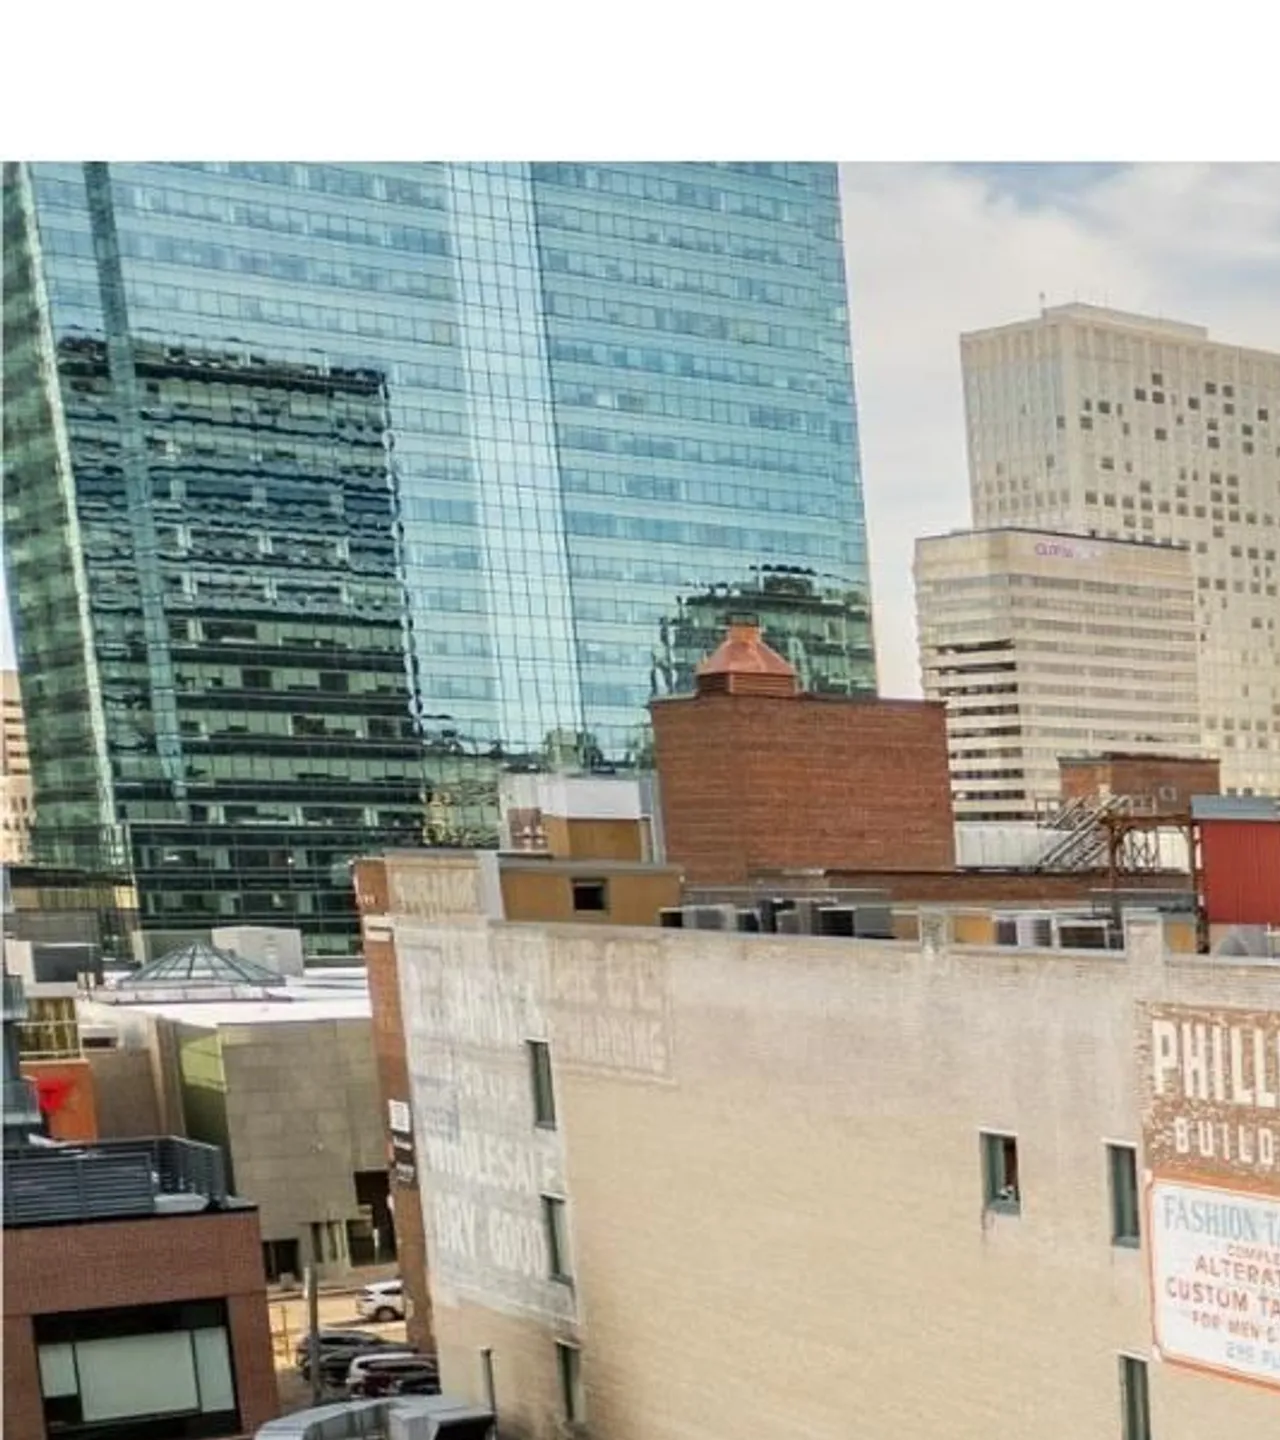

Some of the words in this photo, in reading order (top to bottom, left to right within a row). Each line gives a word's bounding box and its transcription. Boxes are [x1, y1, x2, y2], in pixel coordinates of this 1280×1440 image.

[1162, 1194, 1258, 1243] FASHION
[1165, 1275, 1249, 1313] CUSTOM
[1228, 1317, 1259, 1339] MEN
